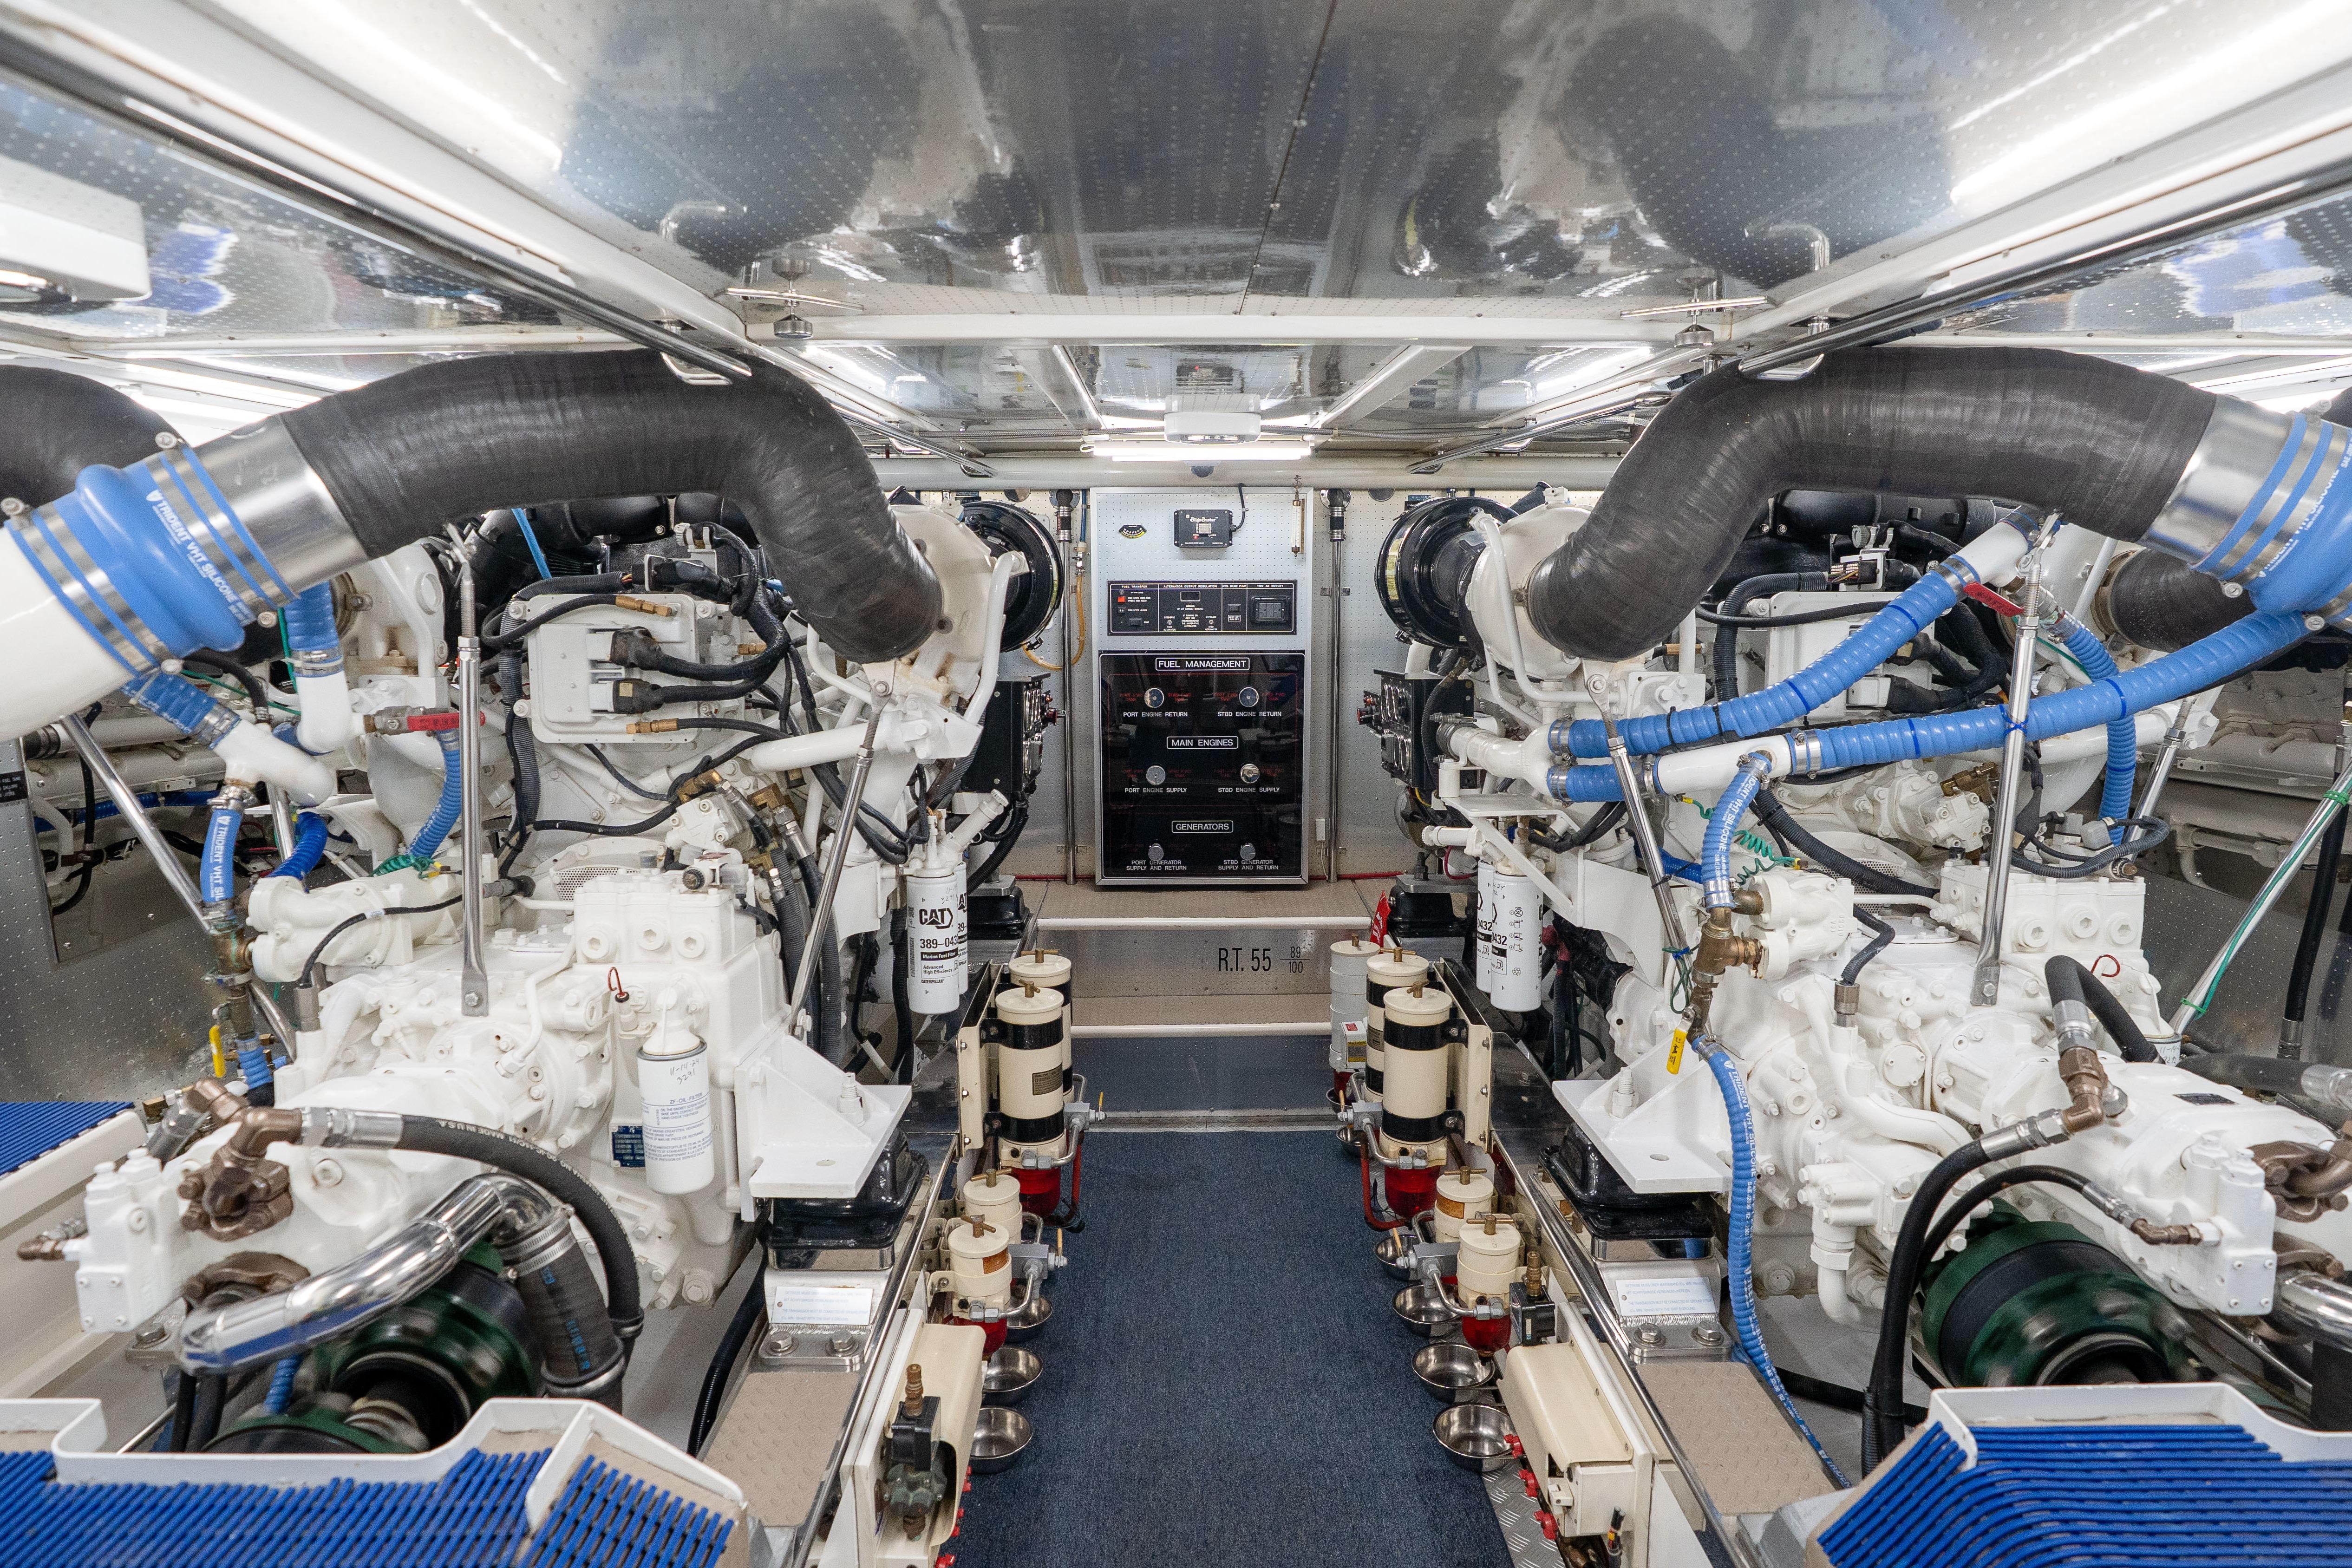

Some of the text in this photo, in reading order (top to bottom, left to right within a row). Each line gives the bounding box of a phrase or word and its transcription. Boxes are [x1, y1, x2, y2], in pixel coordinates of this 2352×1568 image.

[157, 500, 192, 542] TRIDENT
[187, 542, 208, 562] VHT
[202, 563, 238, 603] SILICONE
[1719, 775, 1758, 852] IDENT VHT SILICONE
[213, 826, 229, 863] TRIDENT
[213, 865, 223, 884] VHT
[919, 908, 945, 925] CAT
[1477, 918, 1492, 931] 0432
[1492, 932, 1507, 946] 0432
[1218, 947, 1271, 972] R.T. 55
[1290, 946, 1301, 958] 89
[1288, 961, 1303, 973] 100
[677, 1068, 695, 1085] 3291
[1732, 1070, 1750, 1109] TRIDENT
[1765, 1365, 1773, 1378] SAE
